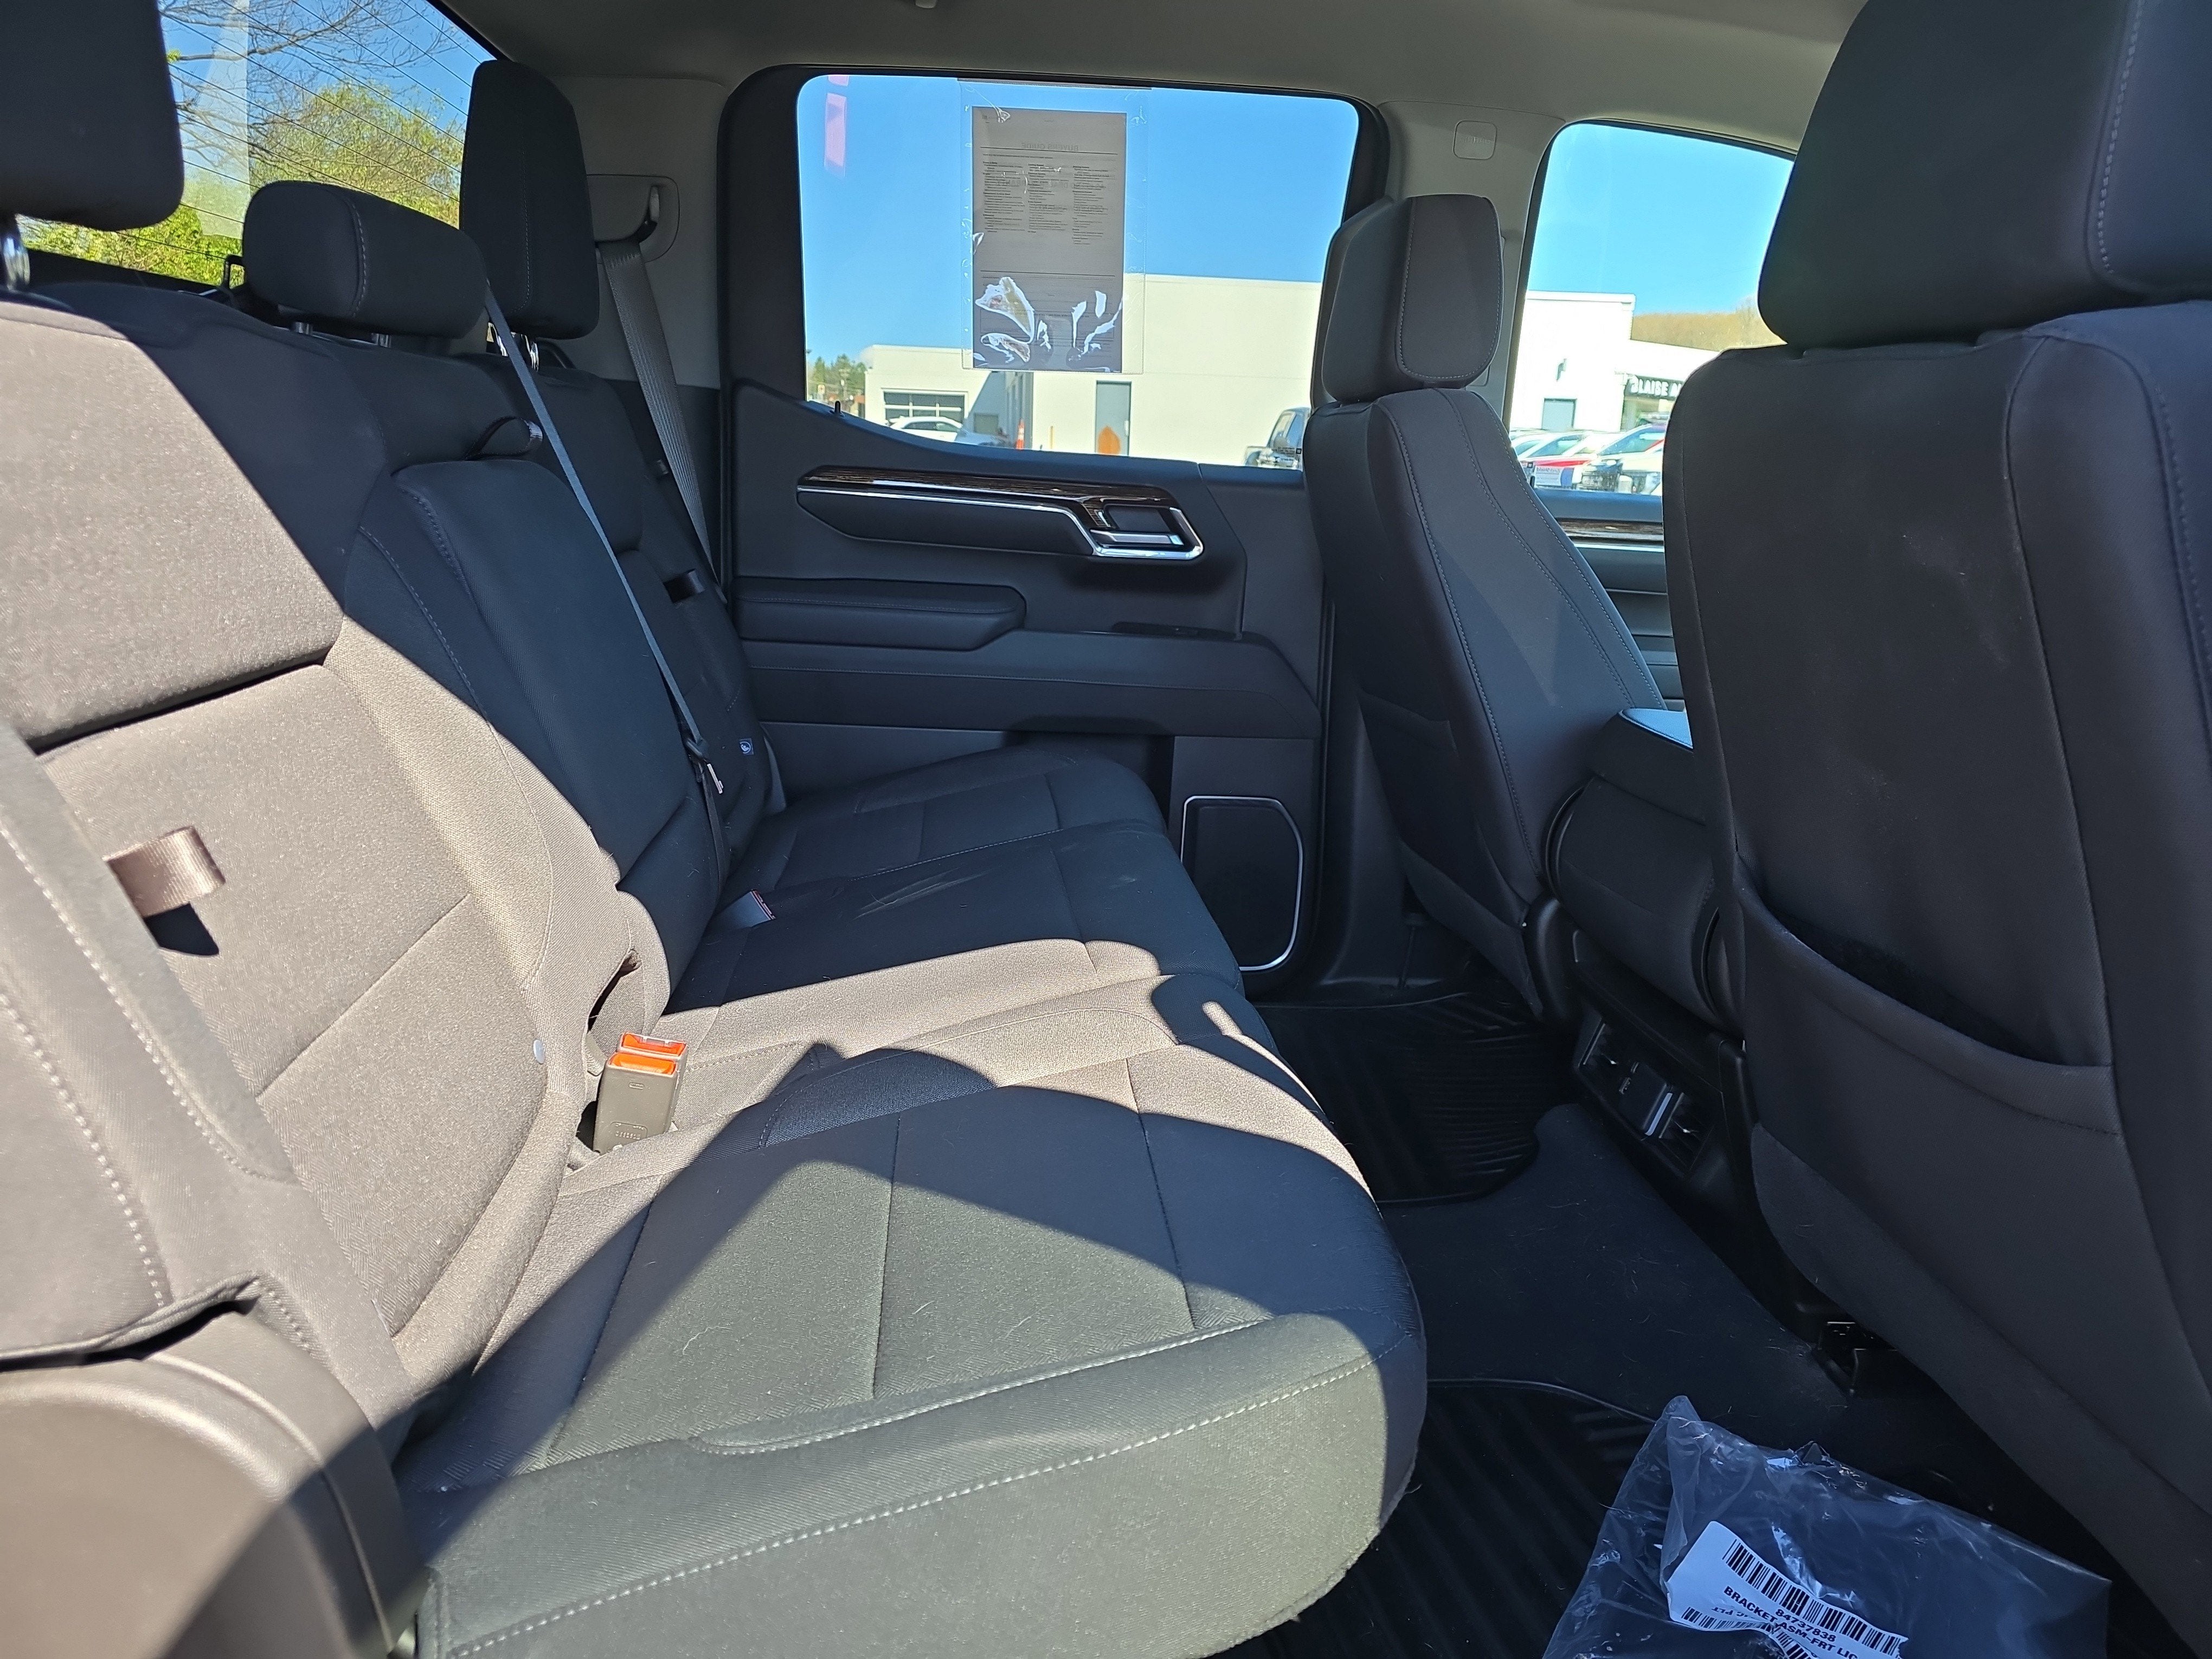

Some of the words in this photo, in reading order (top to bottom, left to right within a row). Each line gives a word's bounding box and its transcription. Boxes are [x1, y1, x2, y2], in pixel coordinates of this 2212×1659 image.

[1630, 376, 1669, 396] BLAISE
[1724, 1585, 1778, 1623] BRACKET
[1774, 1608, 1836, 1642] 84737838
